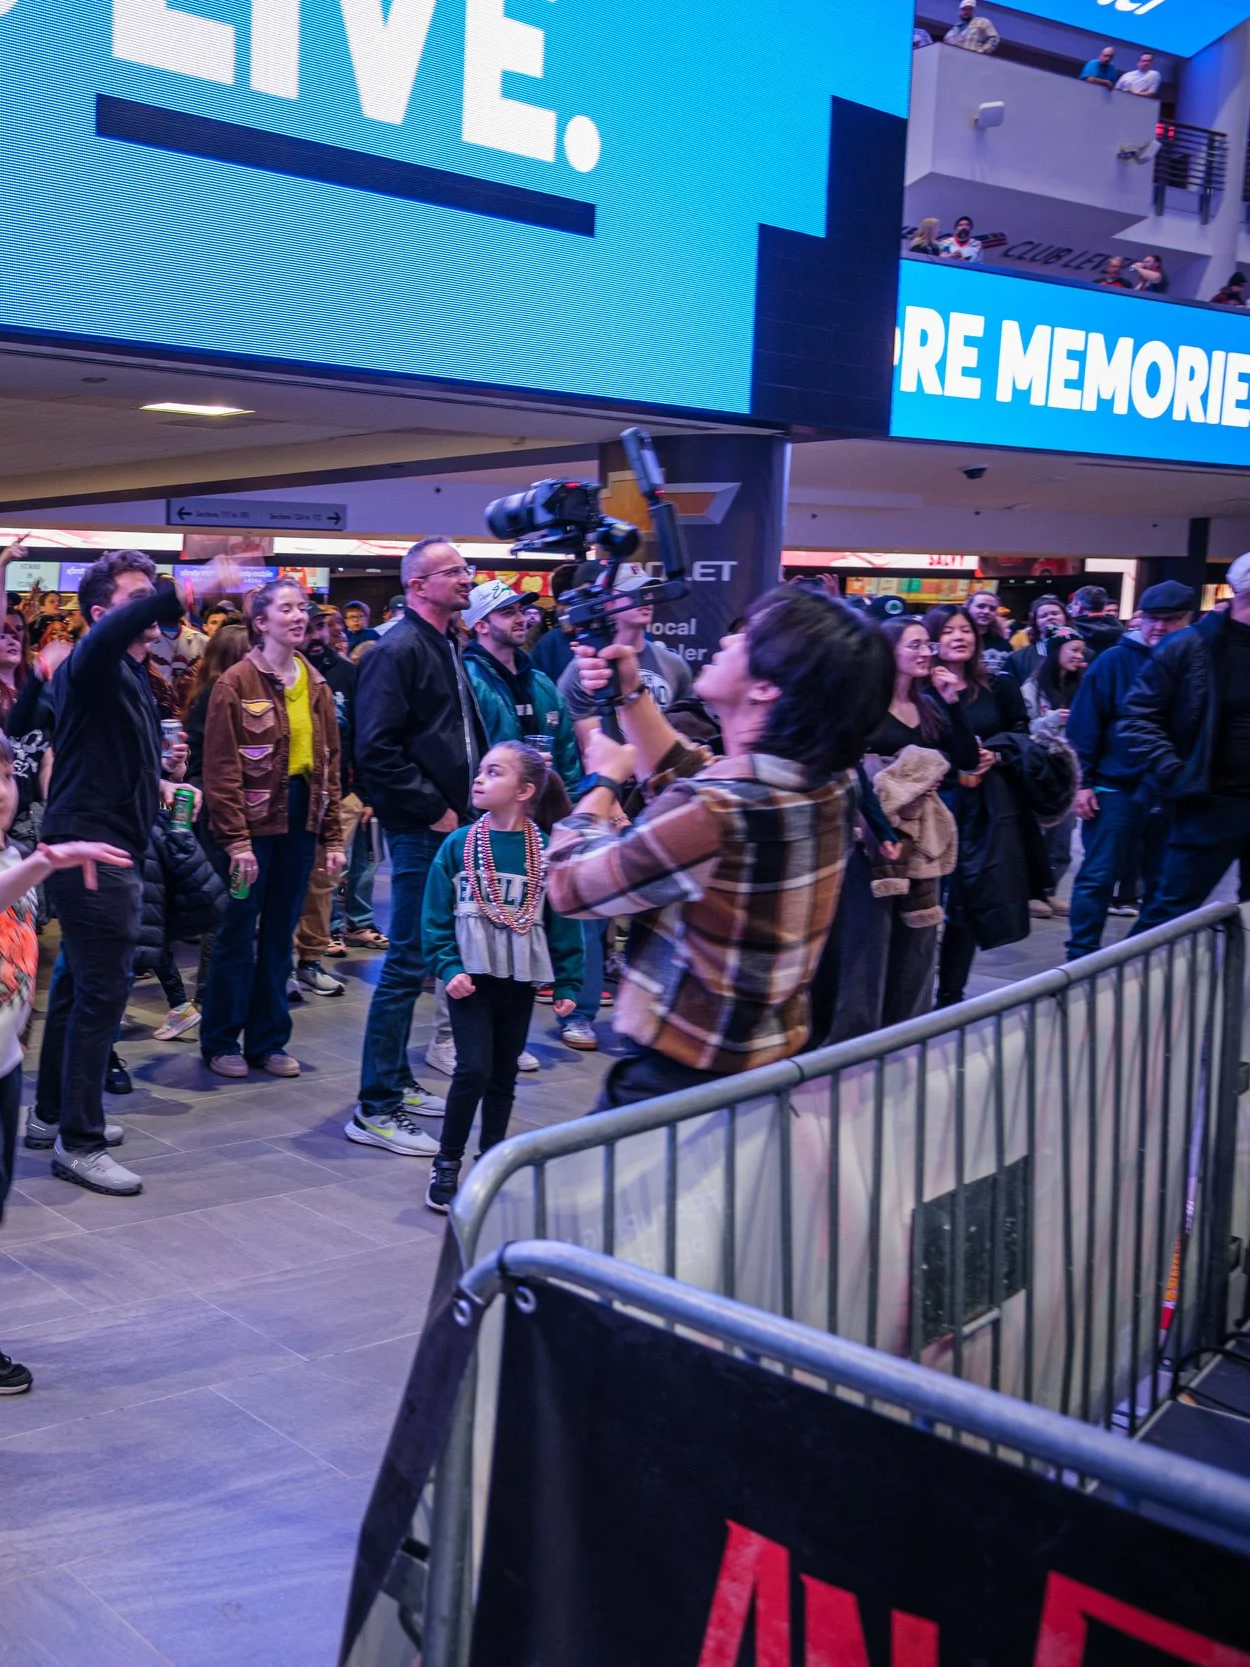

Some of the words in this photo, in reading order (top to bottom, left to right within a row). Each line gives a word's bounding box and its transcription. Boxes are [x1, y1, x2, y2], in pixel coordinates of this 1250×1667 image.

[1002, 241, 1073, 265] CLUB
[1062, 250, 1141, 275] LEV
[893, 305, 985, 400] RE
